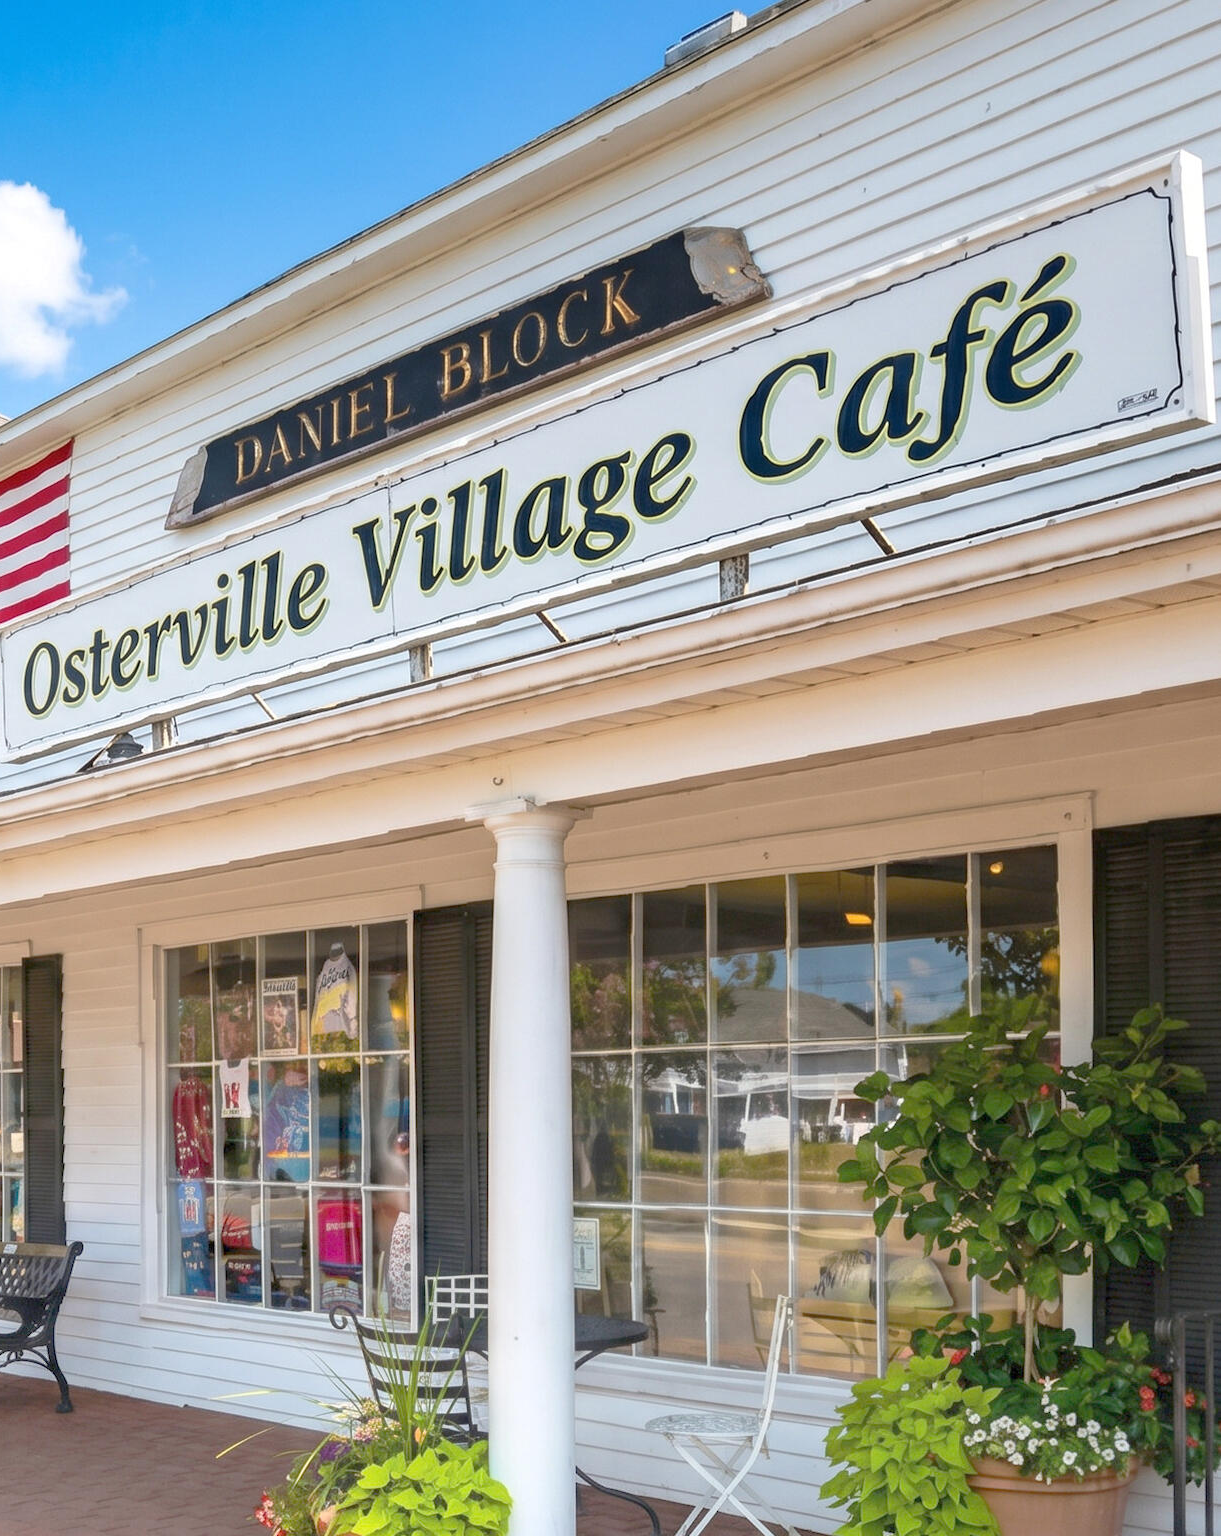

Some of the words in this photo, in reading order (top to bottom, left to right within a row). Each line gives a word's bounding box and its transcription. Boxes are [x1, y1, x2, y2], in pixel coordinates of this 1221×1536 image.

[23, 550, 328, 720] Osterville
[351, 431, 694, 609] Village
[739, 253, 1078, 482] Café
[234, 373, 412, 486] DANIEL
[440, 268, 641, 400] BLOCK
